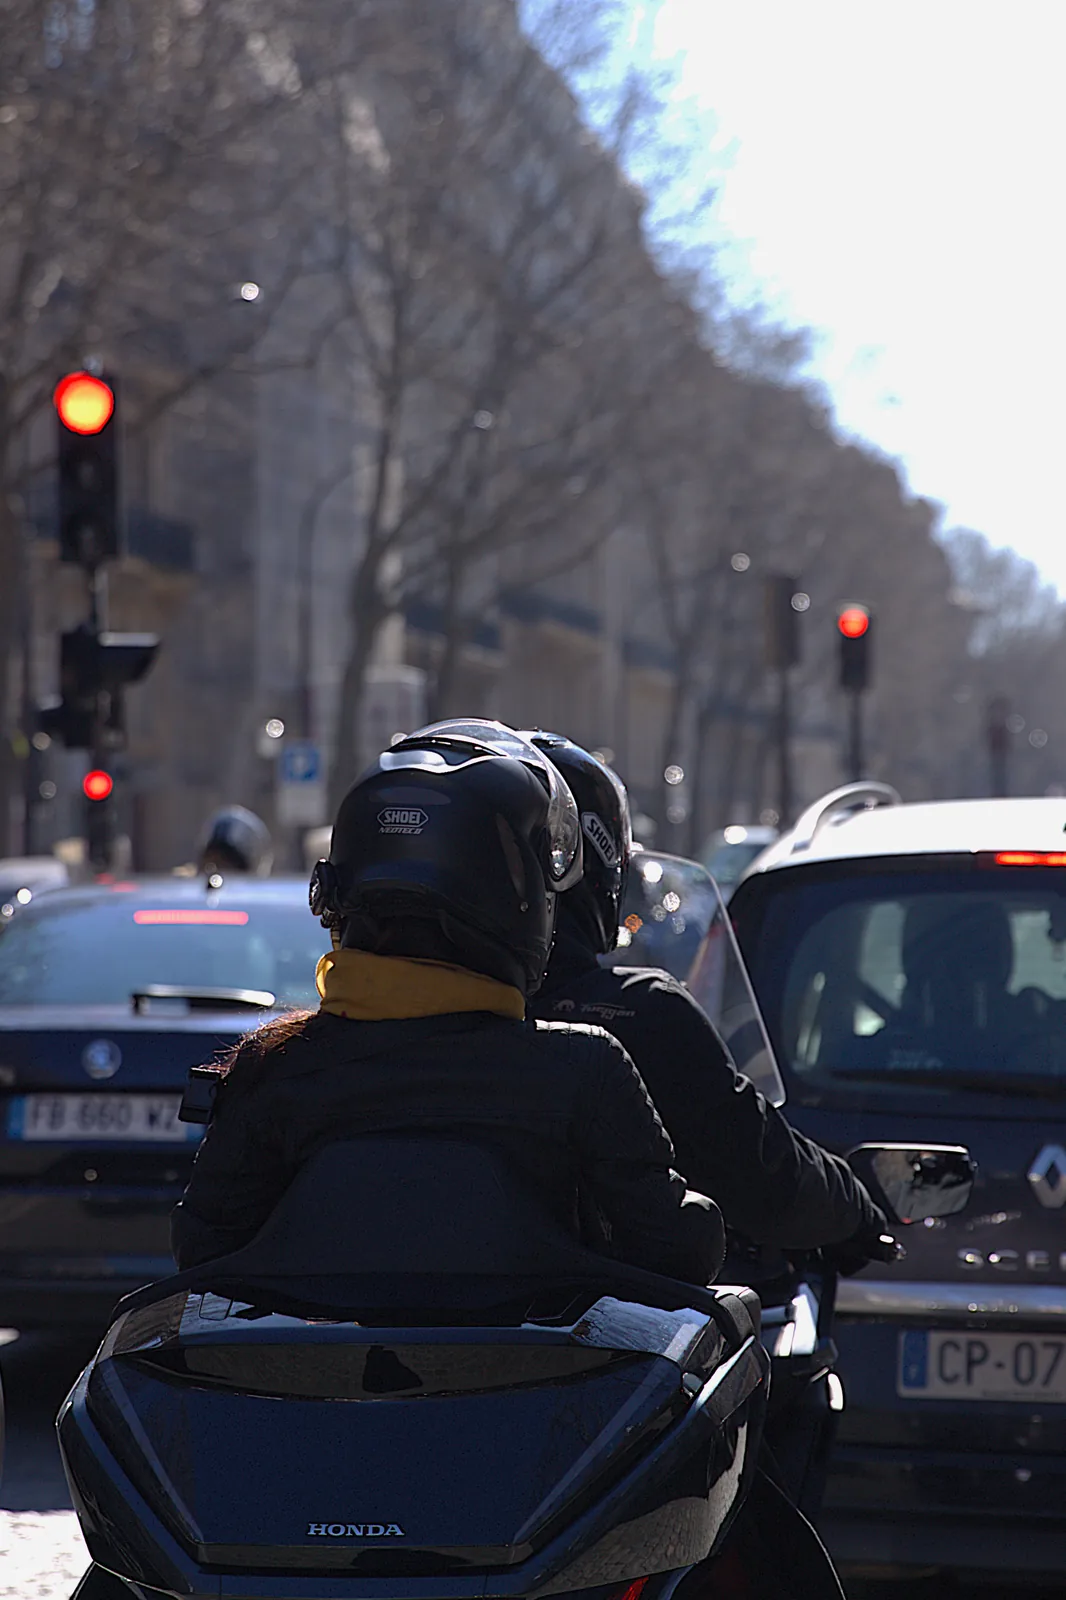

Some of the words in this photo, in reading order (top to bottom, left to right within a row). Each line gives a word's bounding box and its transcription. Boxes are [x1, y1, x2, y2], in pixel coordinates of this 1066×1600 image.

[384, 811, 421, 824] SHOEI
[587, 819, 615, 861] SHOEI
[957, 1248, 1066, 1272] SCE
[307, 1523, 405, 1536] HONDA
